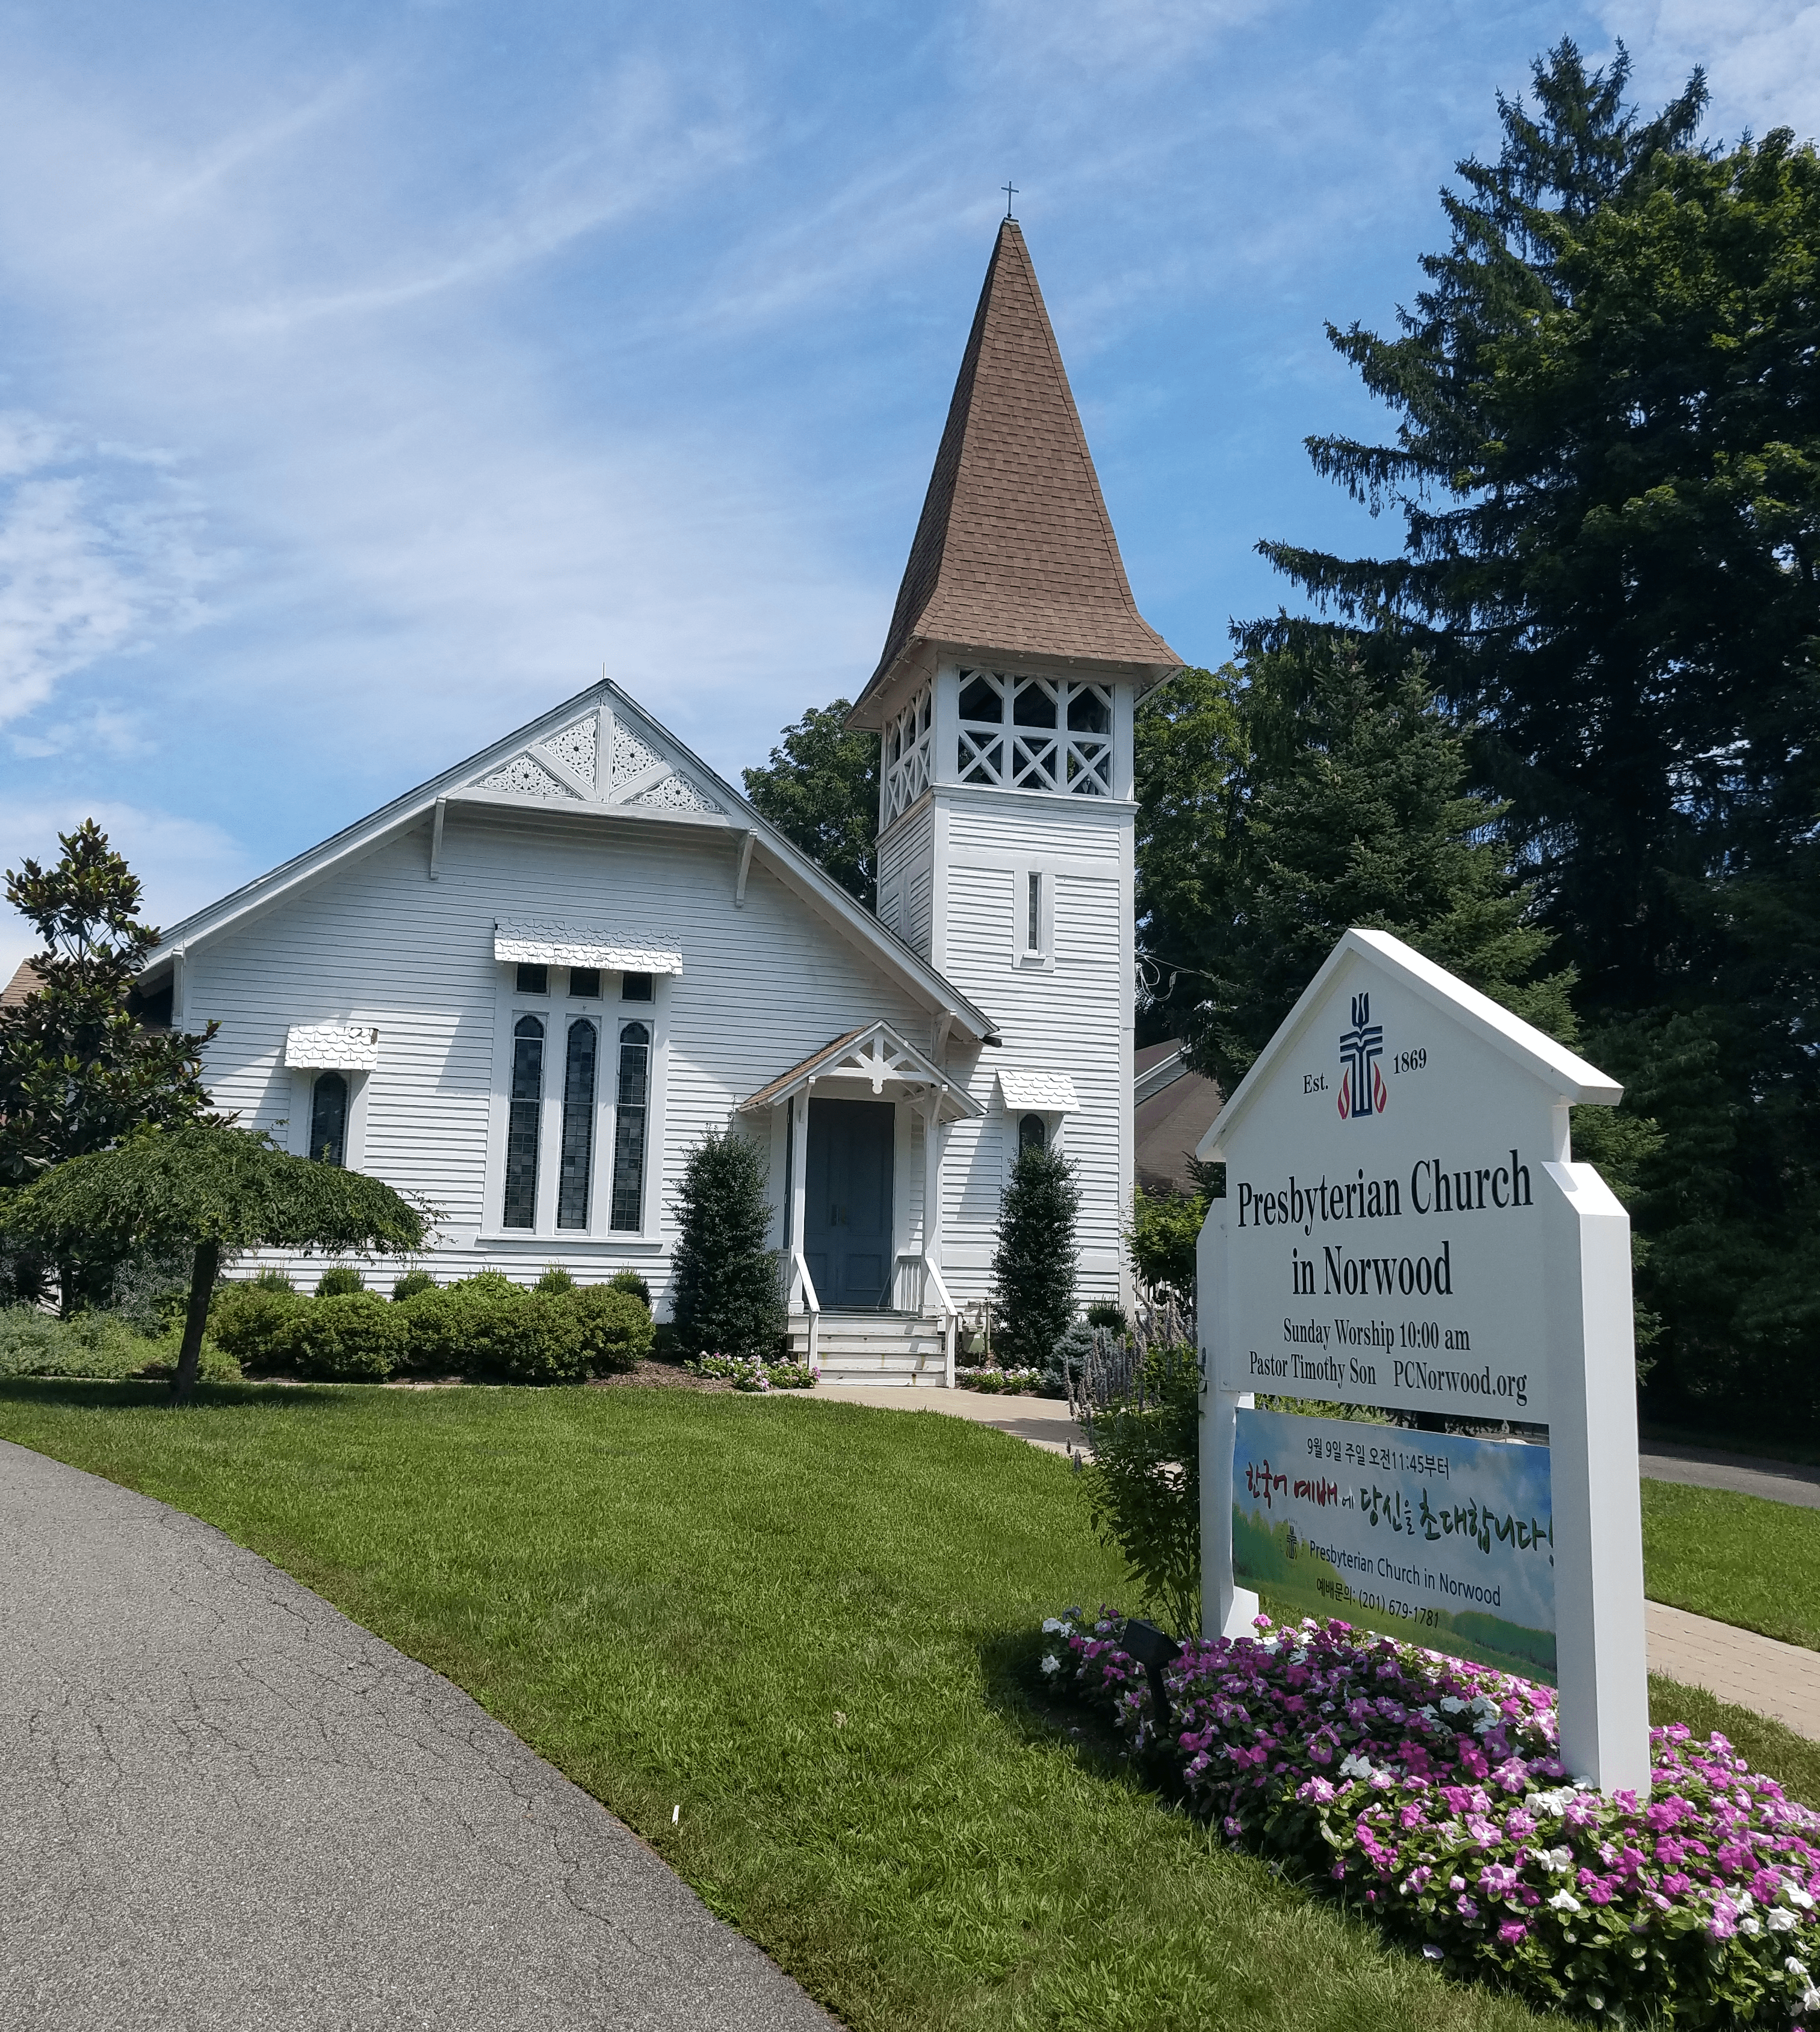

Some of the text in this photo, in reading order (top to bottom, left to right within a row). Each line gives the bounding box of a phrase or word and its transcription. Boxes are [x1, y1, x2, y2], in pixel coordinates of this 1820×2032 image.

[1302, 1047, 1427, 1094] Est. 1869
[1237, 1149, 1533, 1236] Presbyterian Church
[1292, 1241, 1453, 1295] in Norwood
[1284, 1318, 1470, 1354] Sunday Worship 10:00 am
[1249, 1350, 1528, 1406] Pastor Timothy Son PCNorwood.org
[1307, 1437, 1323, 1459] 9월
[1325, 1440, 1342, 1463] 9일
[1345, 1442, 1365, 1466] 주일
[1246, 1460, 1287, 1509] 한국어
[1293, 1476, 1355, 1510] 예배에
[1360, 1485, 1415, 1535] 당신을
[1310, 1540, 1374, 1575] Presbyterian
[1378, 1558, 1420, 1586] Church
[1424, 1568, 1435, 1590] in
[1440, 1573, 1501, 1608] Norwood
[1316, 1578, 1439, 1629] 예배문의: (201) 679-1781
